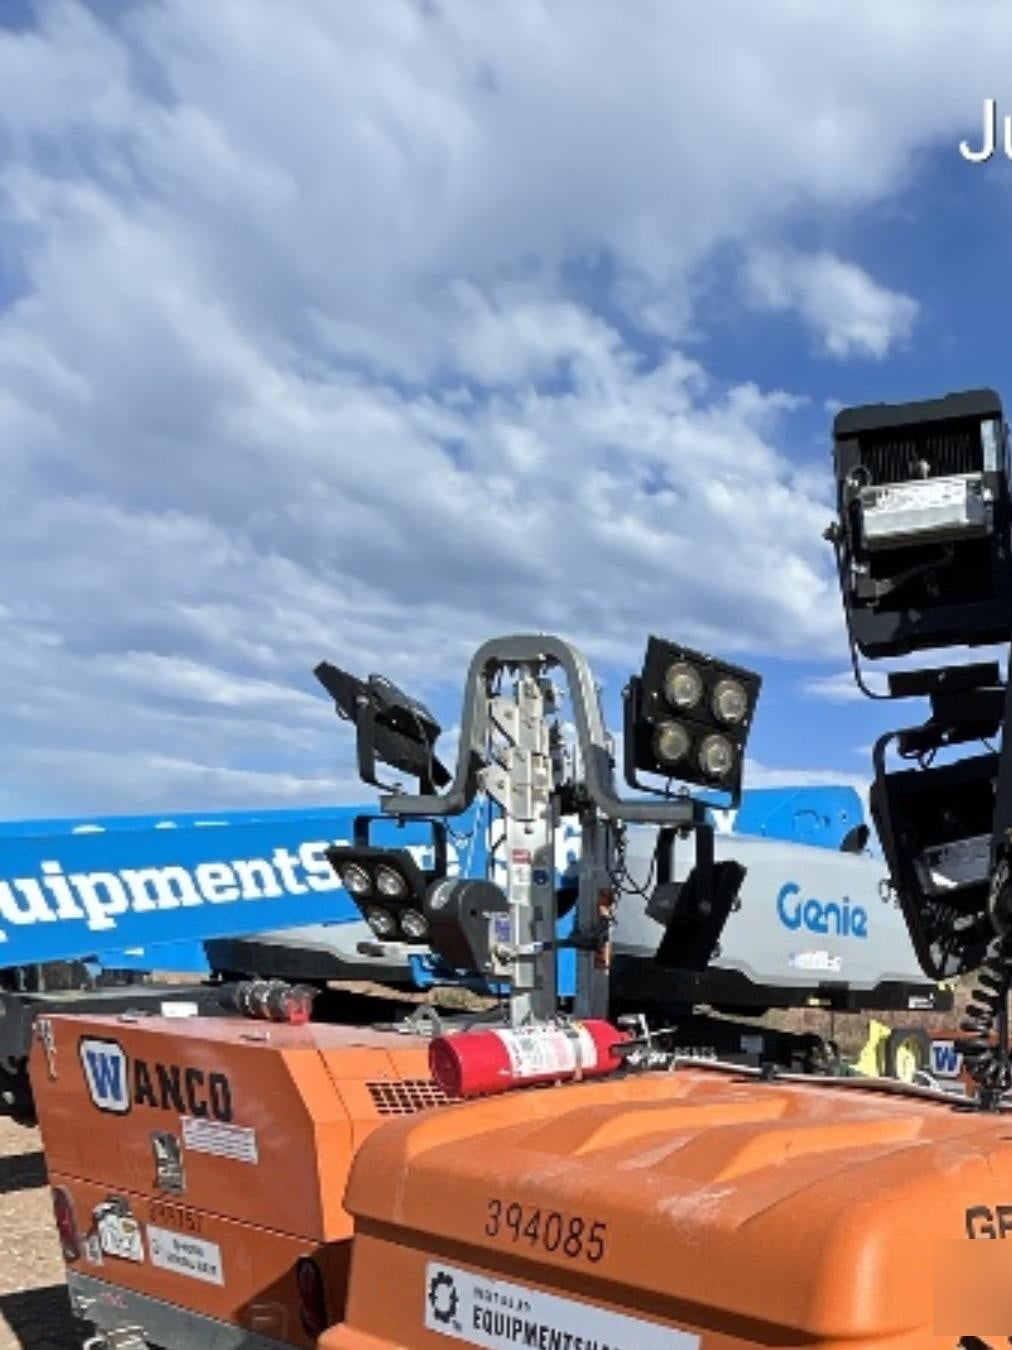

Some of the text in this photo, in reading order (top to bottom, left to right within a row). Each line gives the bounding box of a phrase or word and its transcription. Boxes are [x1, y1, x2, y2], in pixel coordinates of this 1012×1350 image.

[777, 882, 868, 939] Genie
[86, 1049, 232, 1121] WANCO
[485, 1200, 608, 1263] 394085
